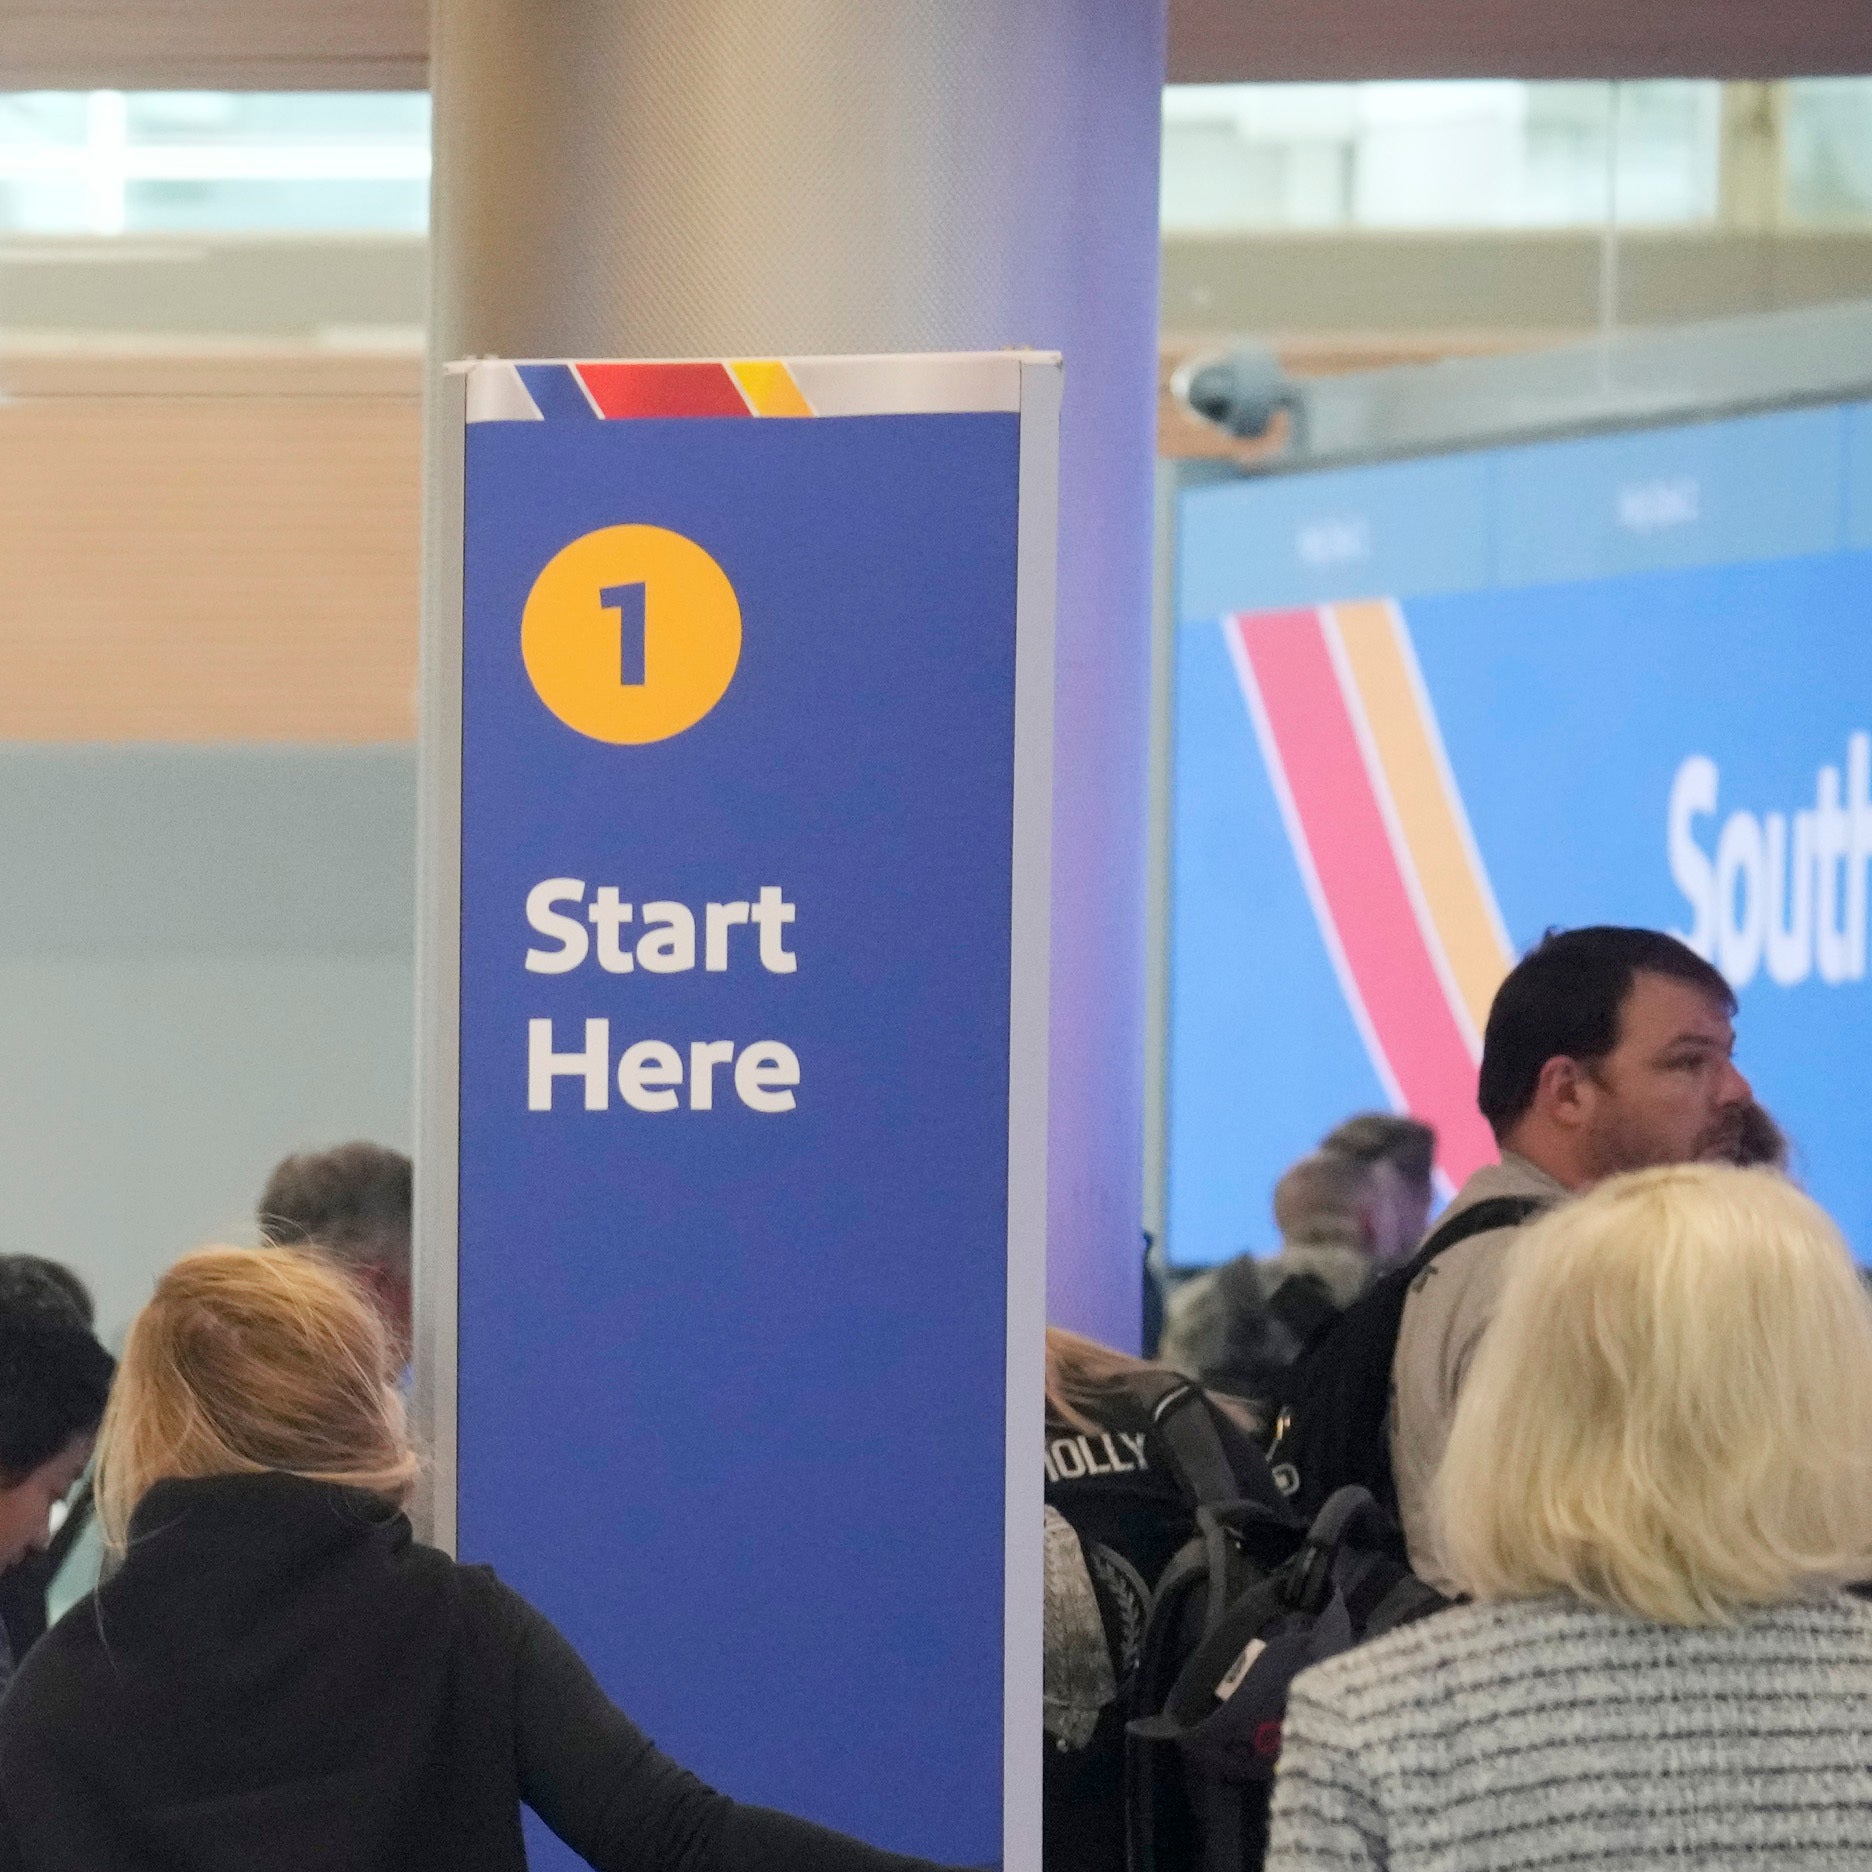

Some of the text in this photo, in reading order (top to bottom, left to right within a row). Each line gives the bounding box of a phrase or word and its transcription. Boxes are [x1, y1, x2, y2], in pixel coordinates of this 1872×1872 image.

[599, 580, 647, 687] 1
[524, 877, 799, 975] Start
[526, 1017, 802, 1113] Here
[1044, 1432, 1149, 1482] OLLY
